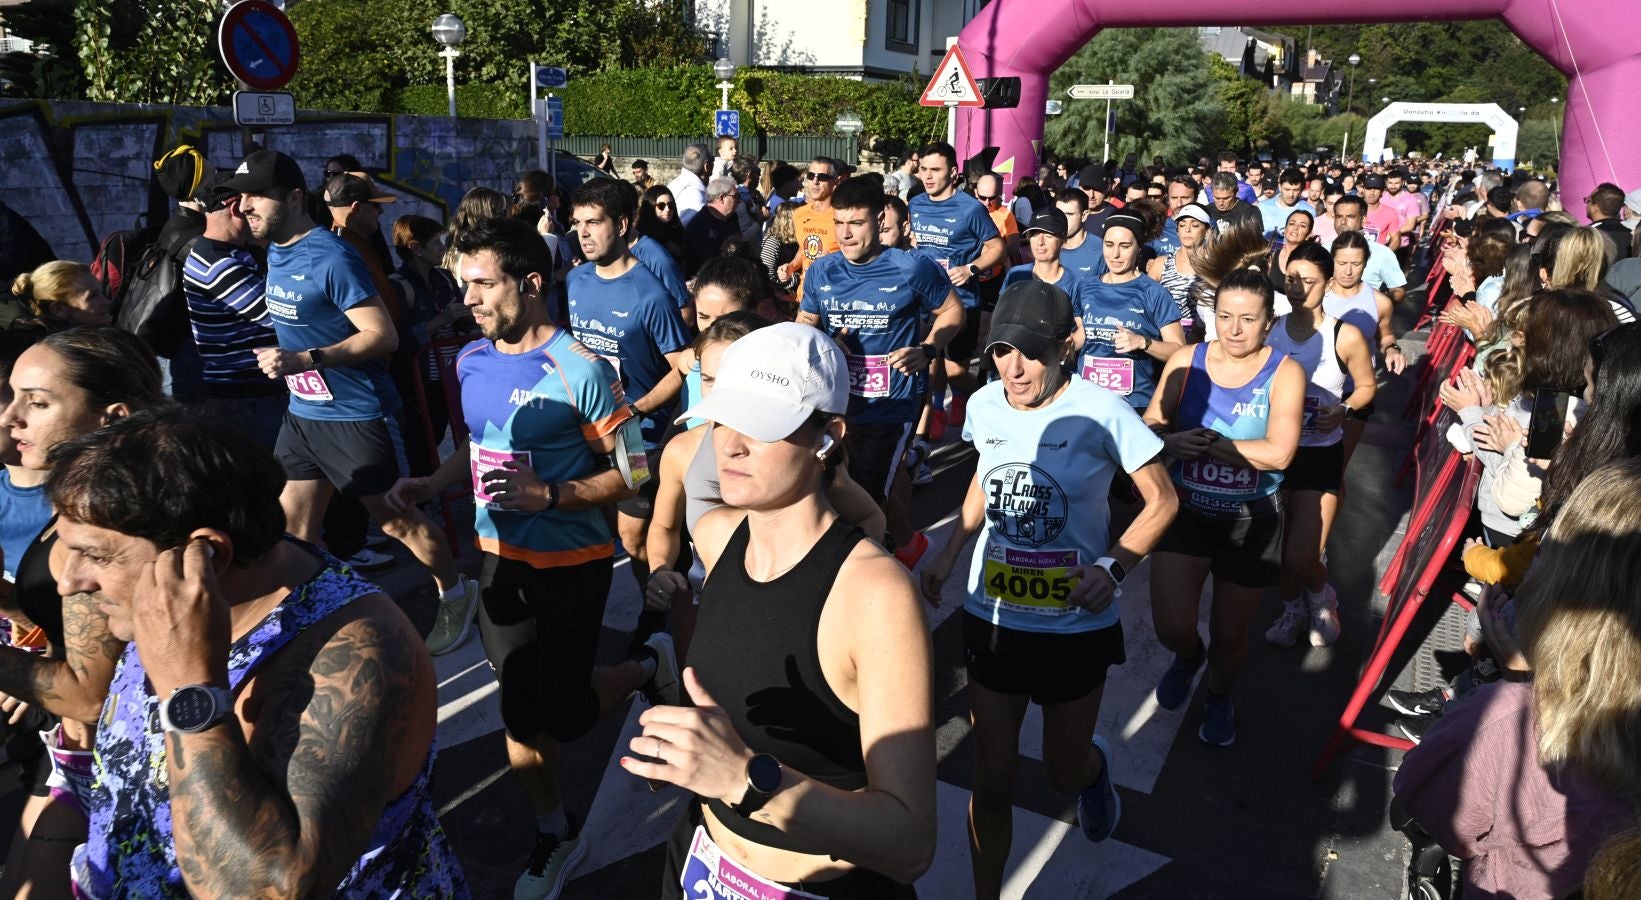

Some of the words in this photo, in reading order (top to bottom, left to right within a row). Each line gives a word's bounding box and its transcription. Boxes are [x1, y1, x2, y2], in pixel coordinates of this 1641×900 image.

[845, 317, 889, 325] KROSSA
[750, 370, 790, 387] OYSHO
[1089, 372, 1122, 388] 952
[1190, 460, 1251, 485] 1054
[989, 479, 1004, 509] 3
[1008, 555, 1037, 564] LABORAL
[1011, 566, 1044, 576] MIREN
[990, 571, 1072, 602] 4005
[720, 867, 760, 898] LABORAL
